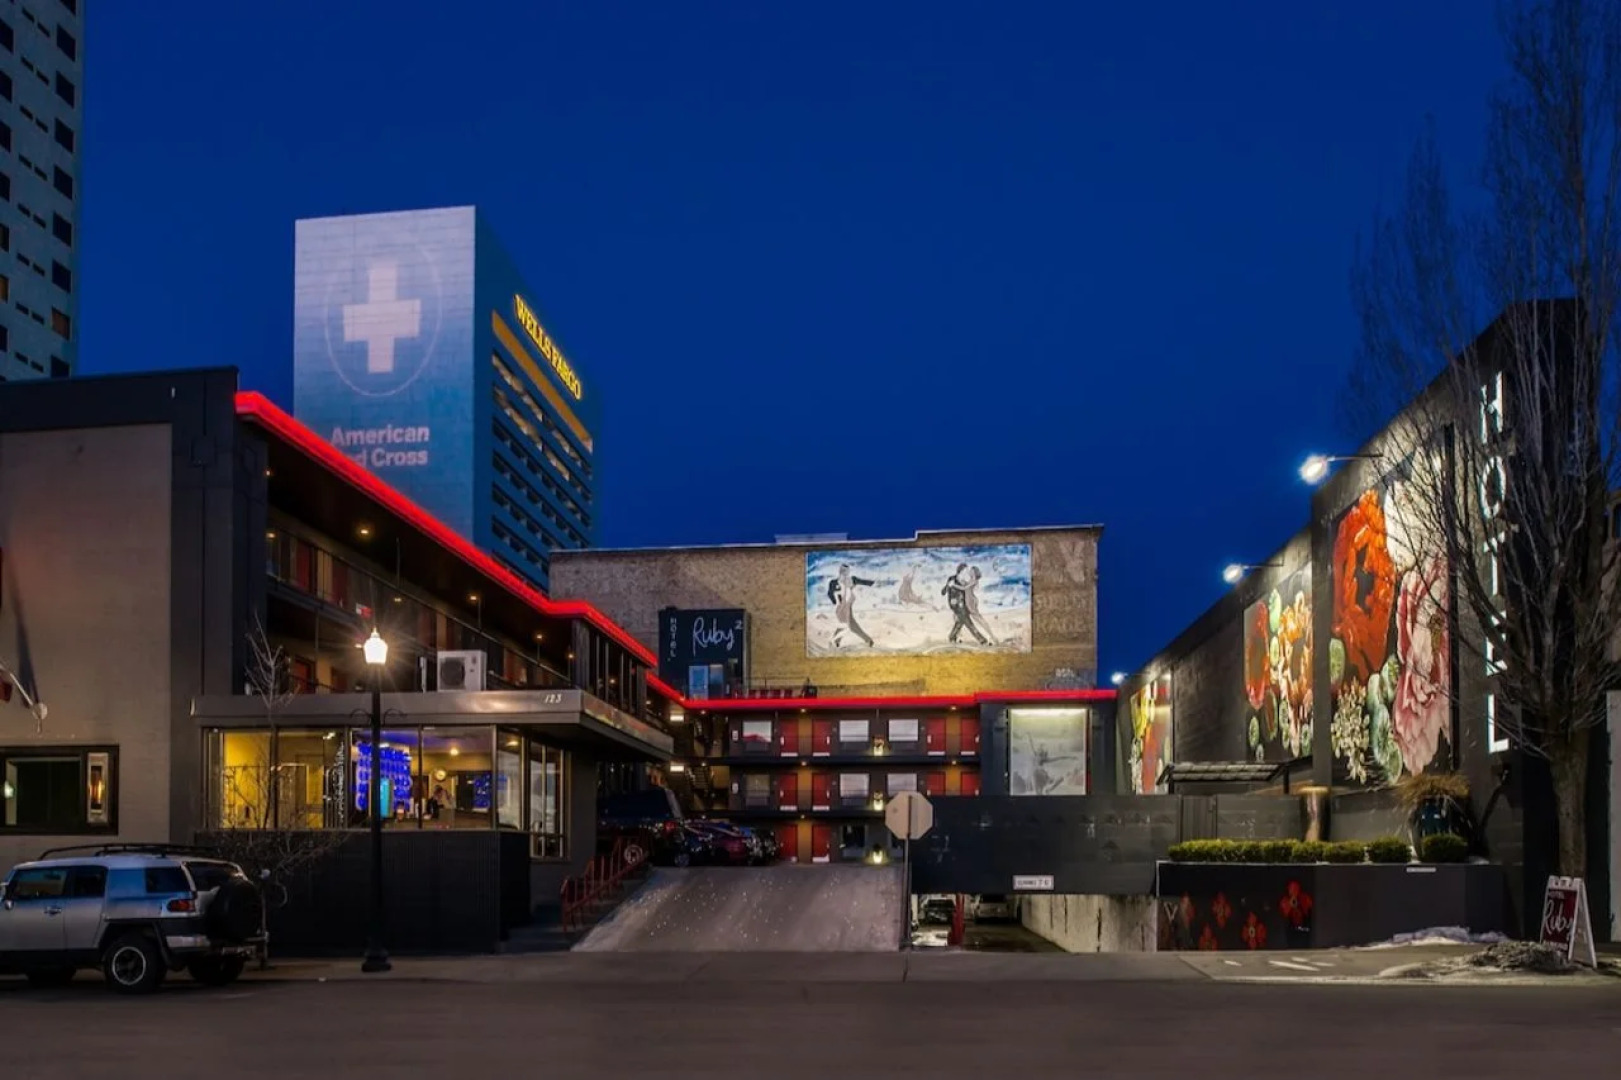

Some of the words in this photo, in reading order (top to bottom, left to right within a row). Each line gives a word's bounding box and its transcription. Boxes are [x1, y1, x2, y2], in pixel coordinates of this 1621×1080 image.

[513, 293, 552, 360] WELLS
[550, 344, 581, 400] FARGO
[331, 424, 430, 446] American
[371, 447, 428, 467] Cross
[545, 693, 562, 704] 123
